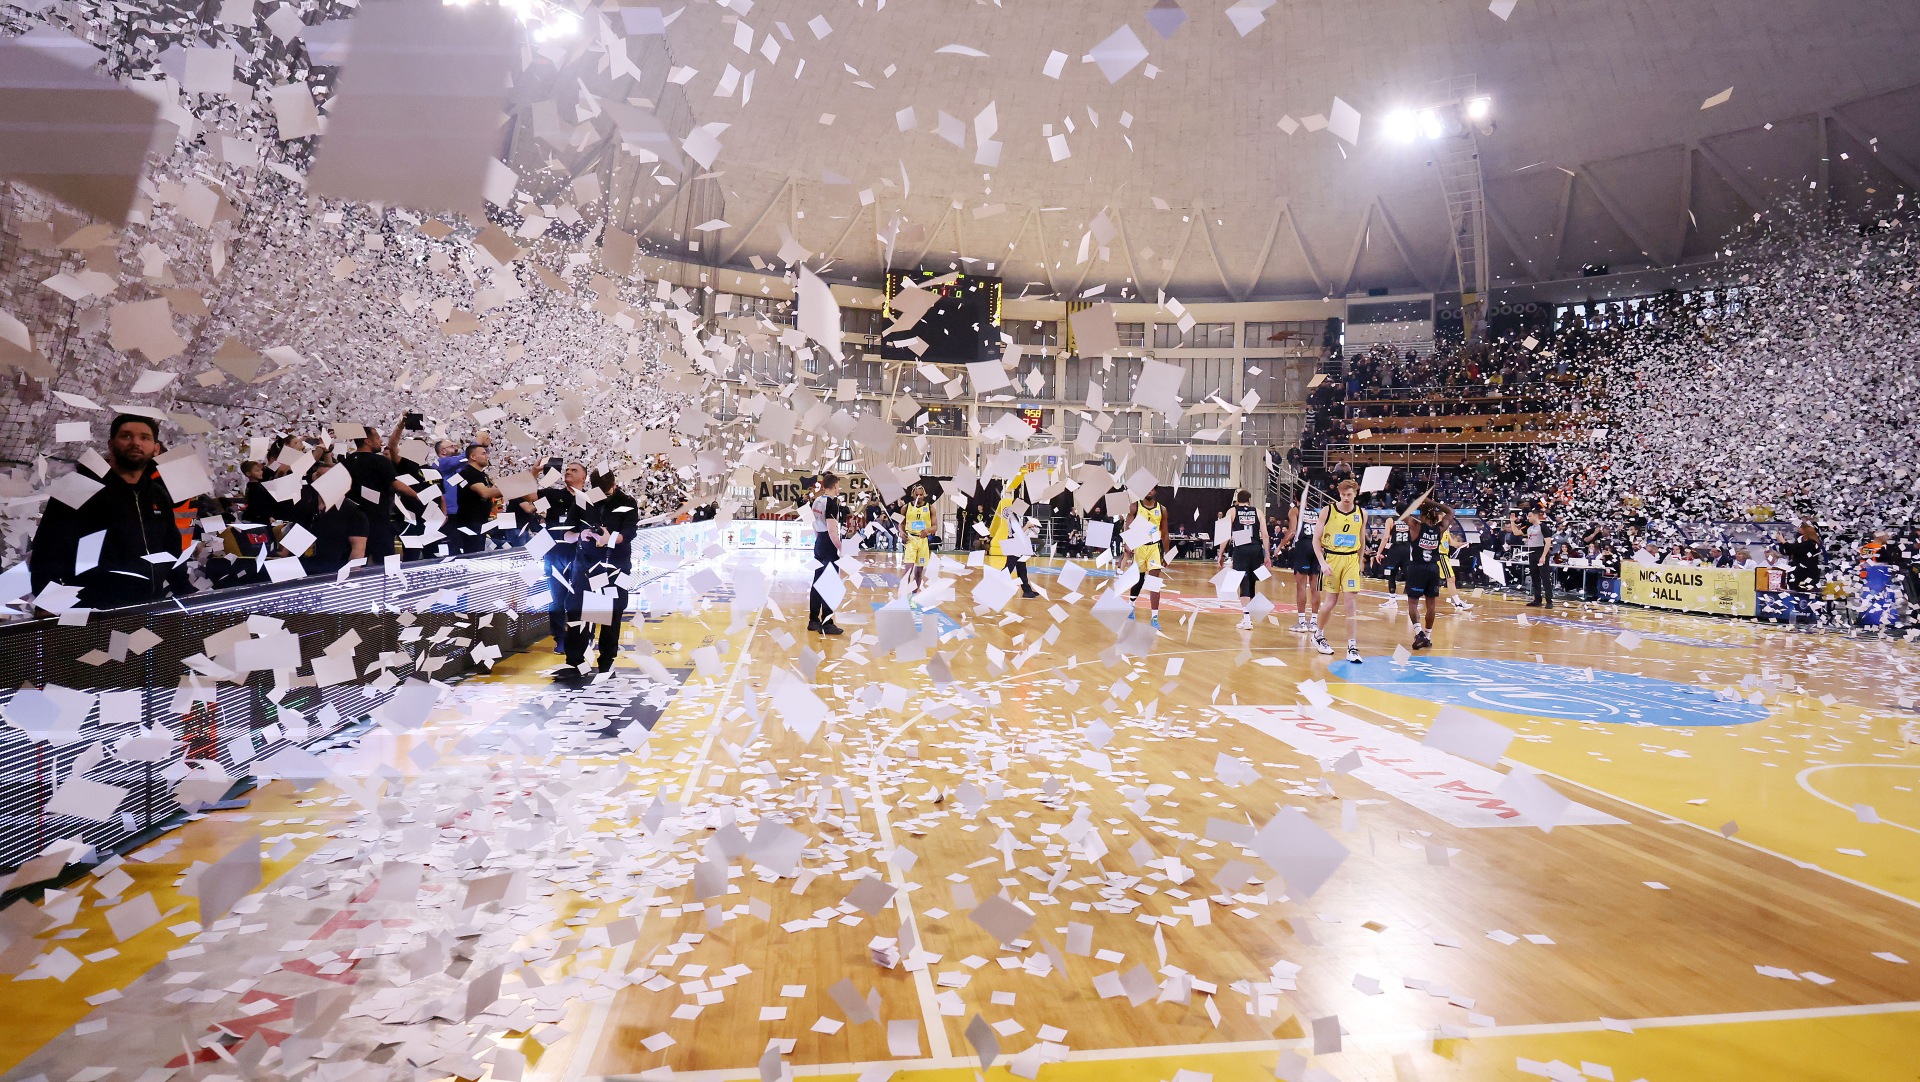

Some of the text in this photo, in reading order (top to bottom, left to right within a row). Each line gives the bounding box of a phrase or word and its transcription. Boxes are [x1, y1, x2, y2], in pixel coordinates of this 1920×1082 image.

[955, 290, 962, 298] 0
[758, 480, 800, 502] ARIS
[1342, 523, 1350, 532] 0
[1395, 532, 1409, 542] 22
[1422, 550, 1433, 562] 5
[1639, 570, 1703, 587] NICK GALIS
[1652, 587, 1683, 602] HALL
